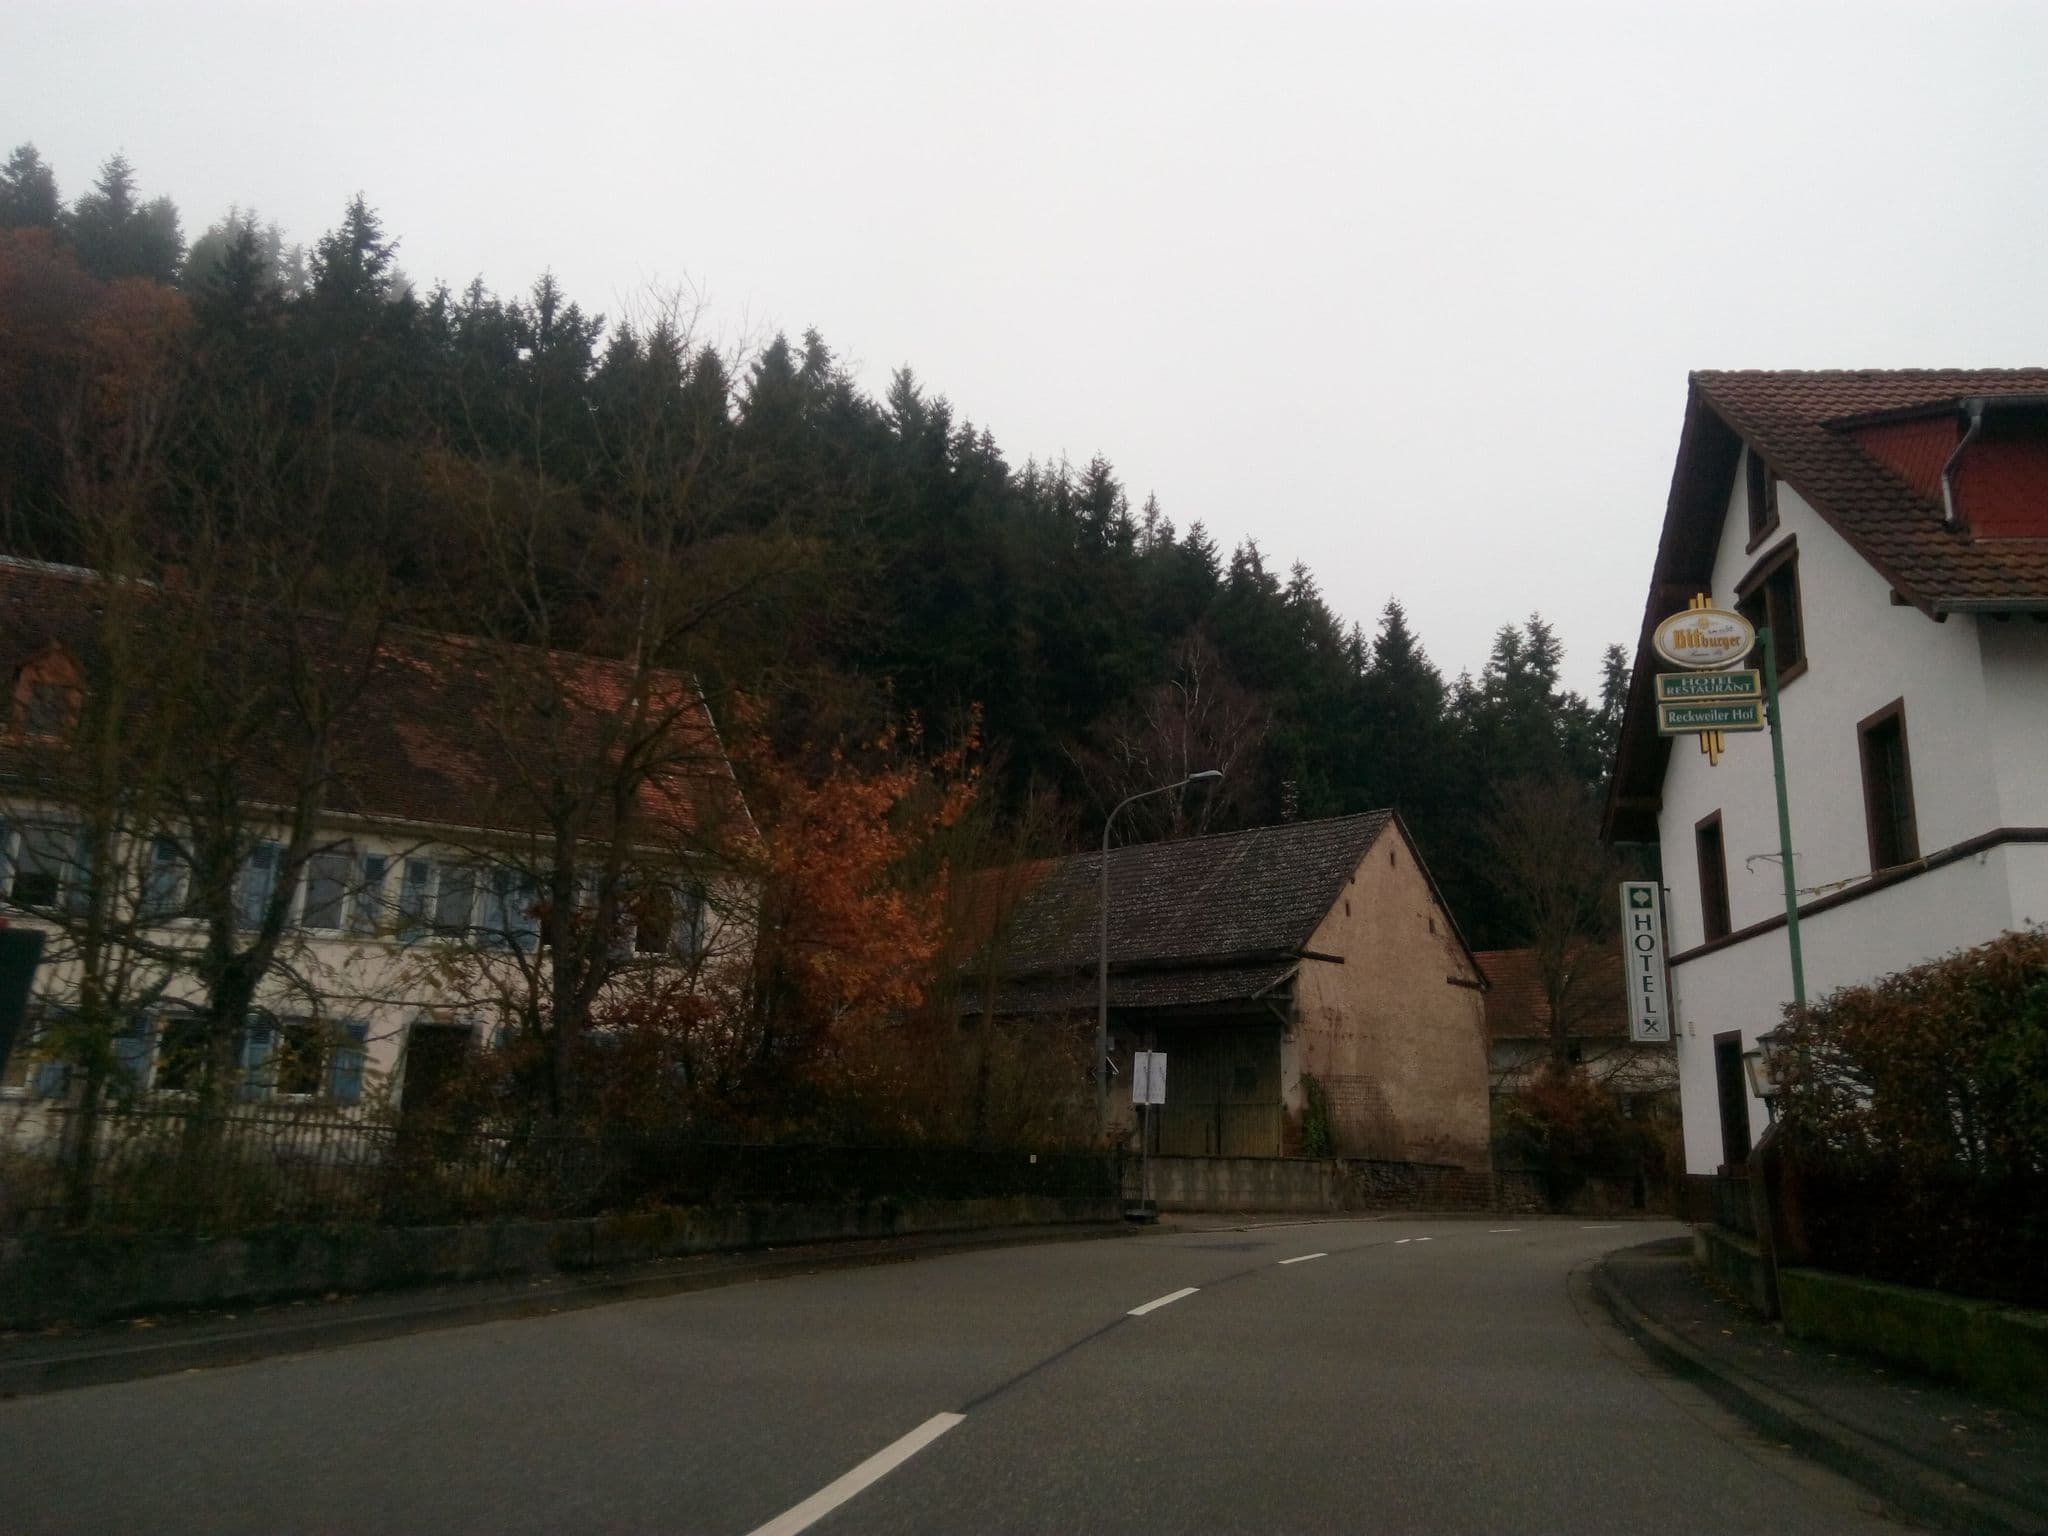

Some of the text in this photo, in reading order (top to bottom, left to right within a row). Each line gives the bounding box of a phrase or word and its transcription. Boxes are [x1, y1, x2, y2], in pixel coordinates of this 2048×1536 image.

[1673, 628, 1741, 650] Bitburger
[1681, 676, 1734, 686] HOTEL
[1667, 683, 1752, 695] RESTAURANT
[1668, 709, 1754, 723] Reckweiler Hof
[1634, 914, 1657, 1014] HOTEL
